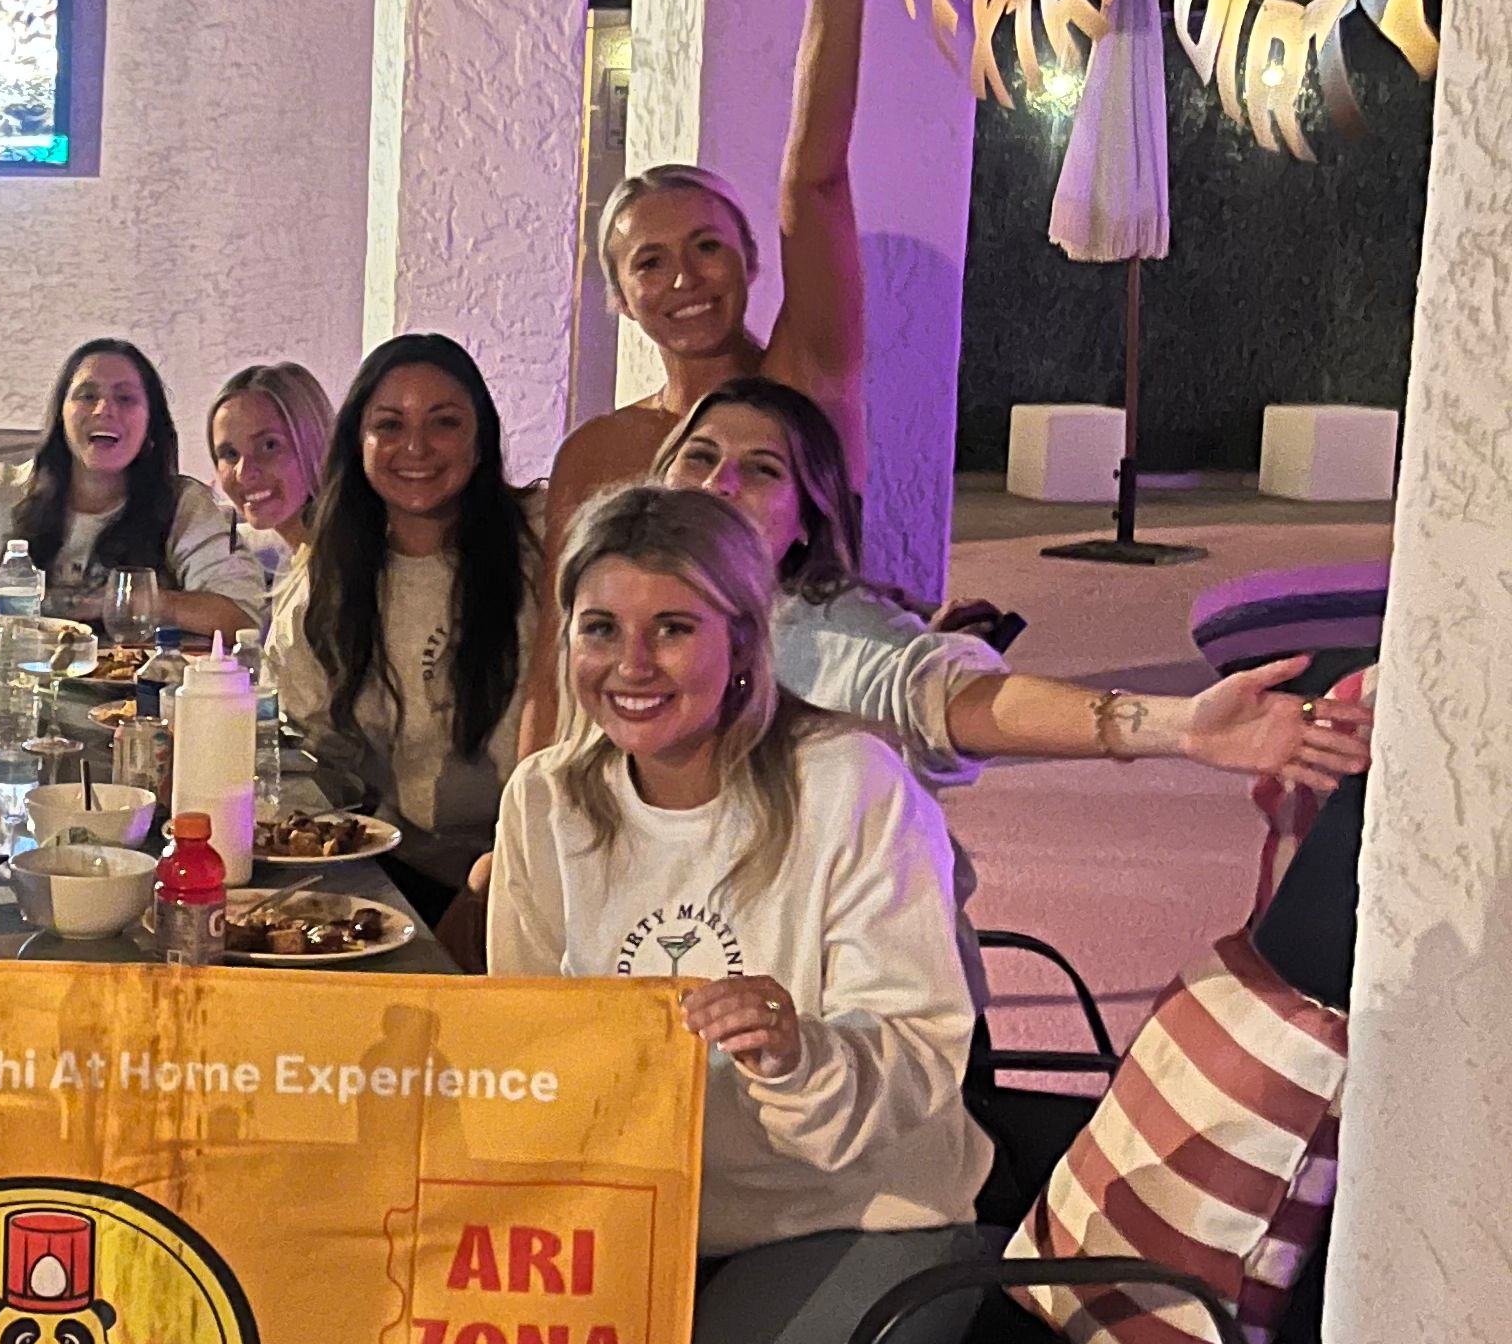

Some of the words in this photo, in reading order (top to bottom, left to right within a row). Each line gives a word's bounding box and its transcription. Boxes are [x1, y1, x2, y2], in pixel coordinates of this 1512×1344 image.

[617, 907, 667, 975] DIRTY
[676, 903, 744, 976] MARTINI
[50, 1050, 106, 1090] At
[120, 1051, 260, 1094] Home
[275, 1054, 560, 1104] Experience
[445, 1224, 595, 1296] ARI
